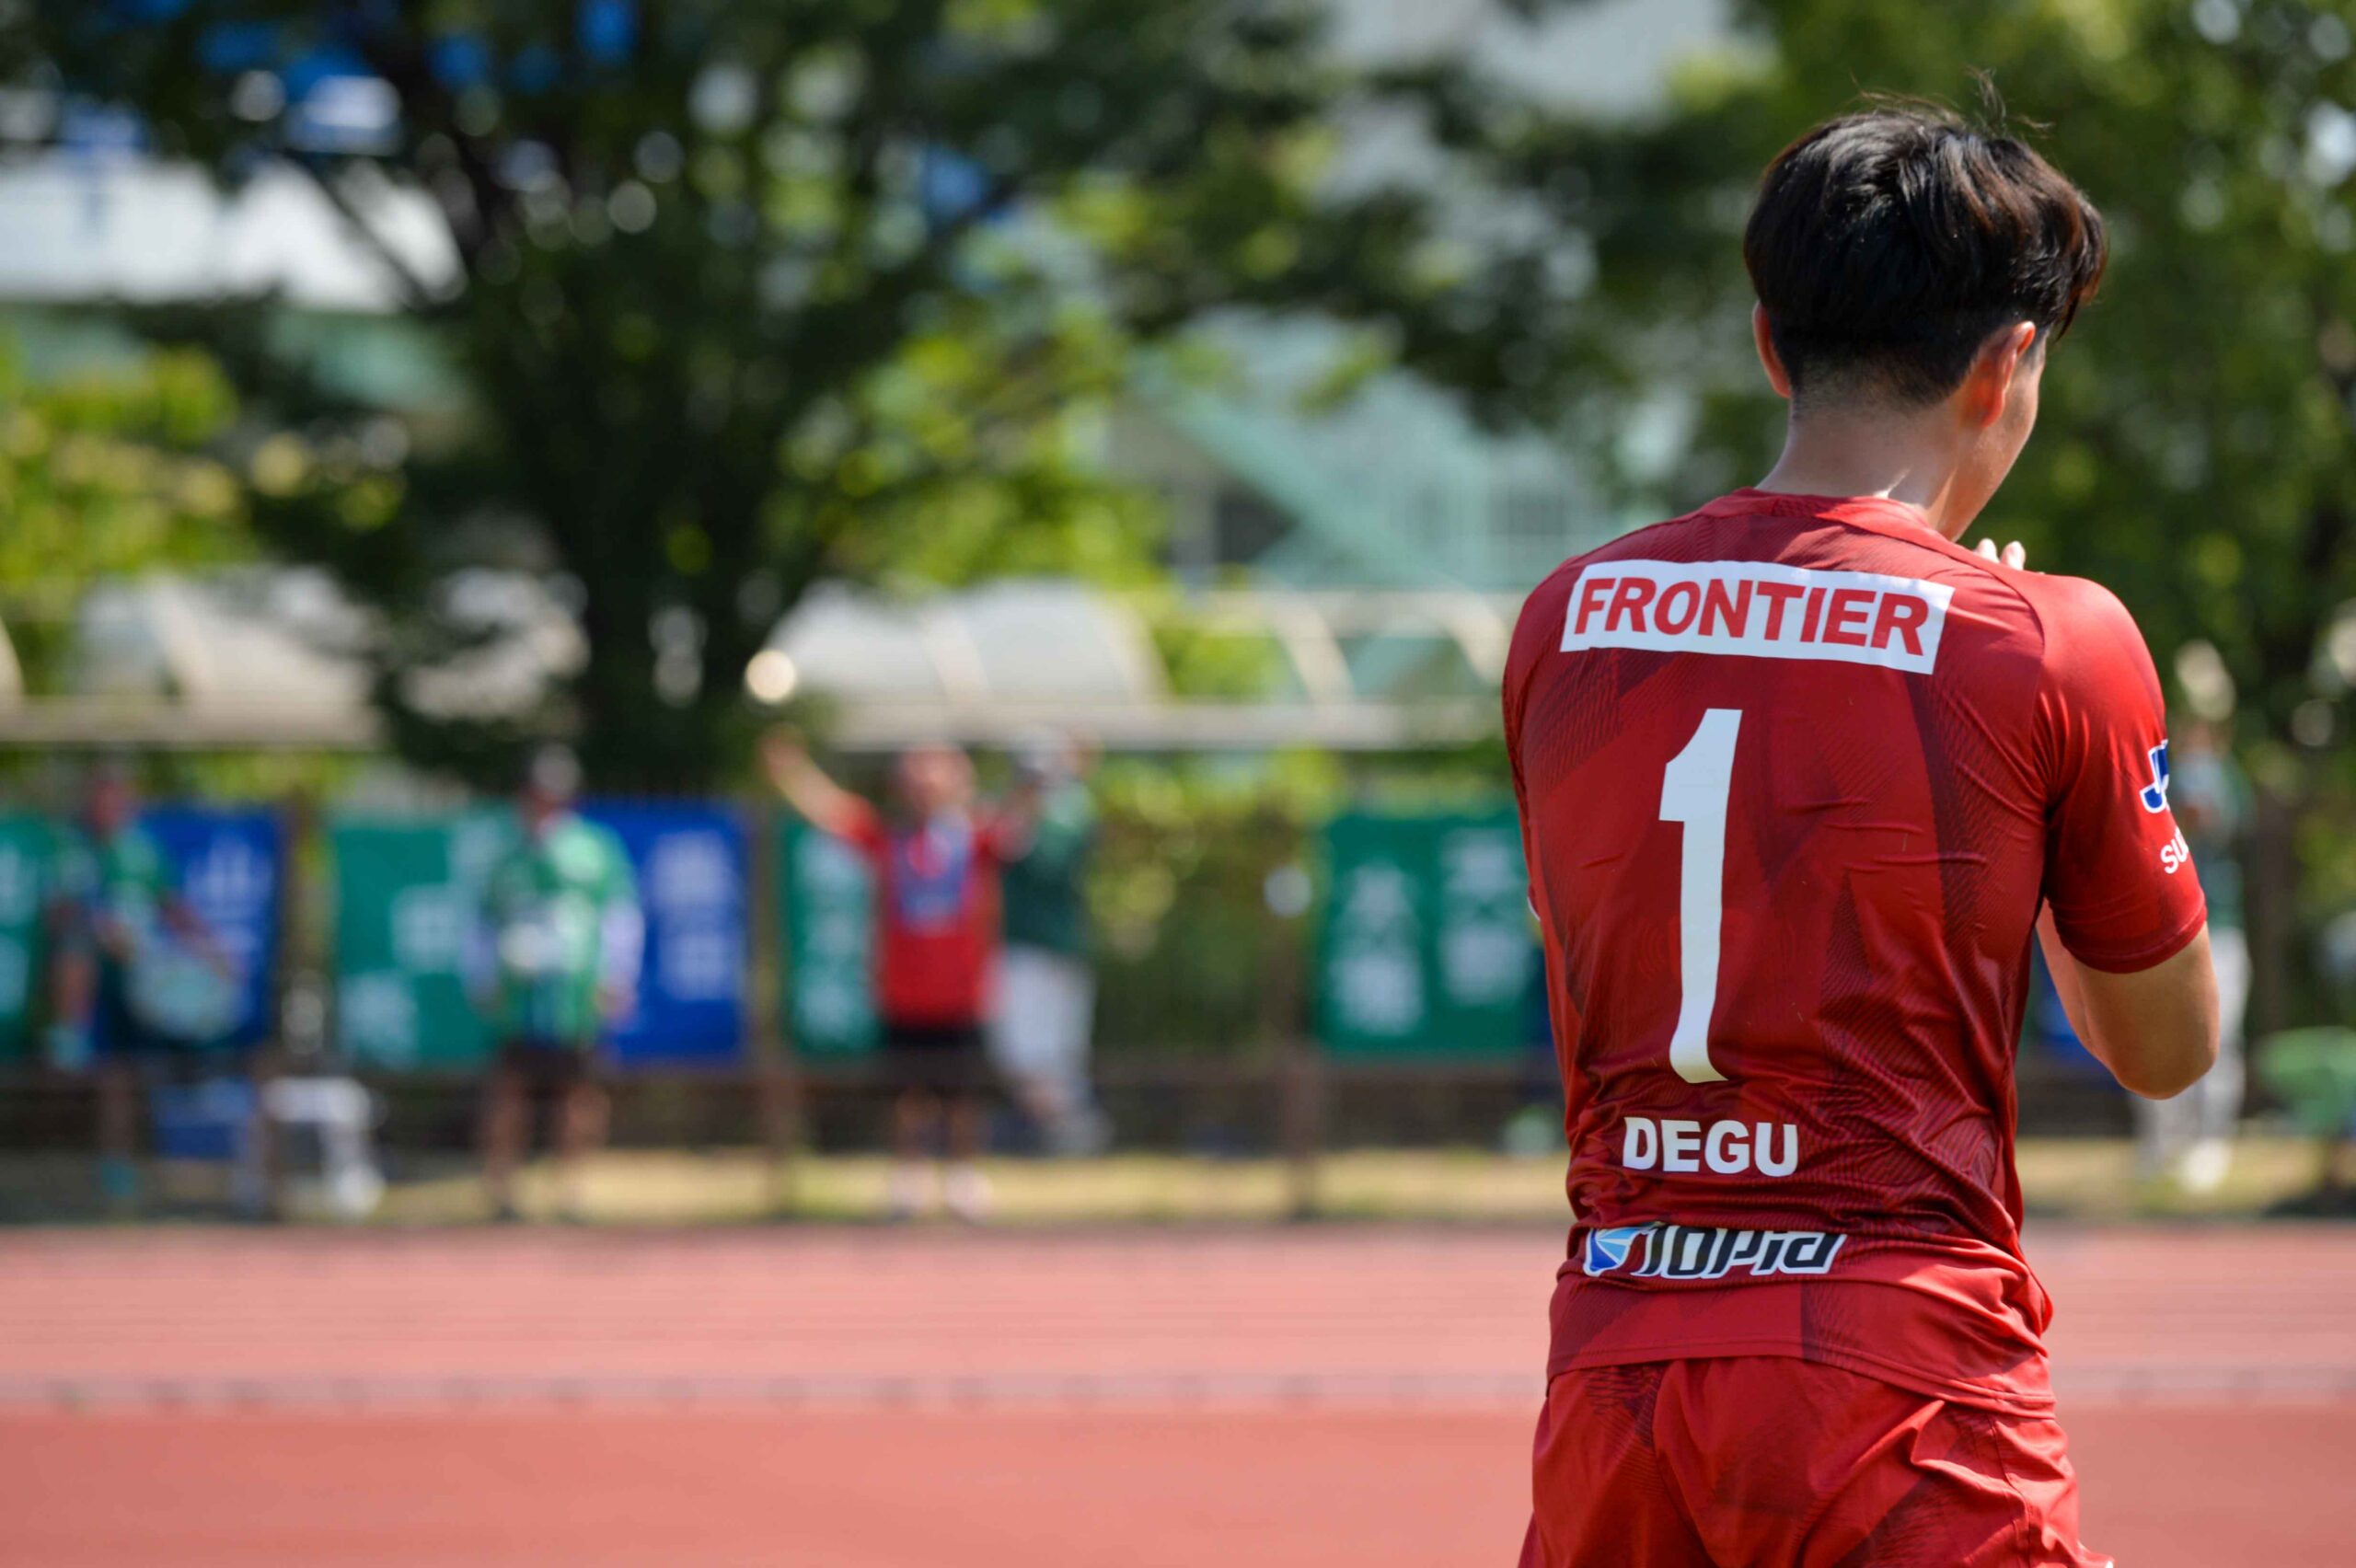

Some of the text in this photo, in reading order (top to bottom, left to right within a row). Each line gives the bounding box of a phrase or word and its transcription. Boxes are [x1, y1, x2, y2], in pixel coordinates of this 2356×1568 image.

[1574, 576, 1929, 656] FRONTIER
[1659, 708, 1743, 1084] 1
[1623, 1116, 1798, 1177] DEGU
